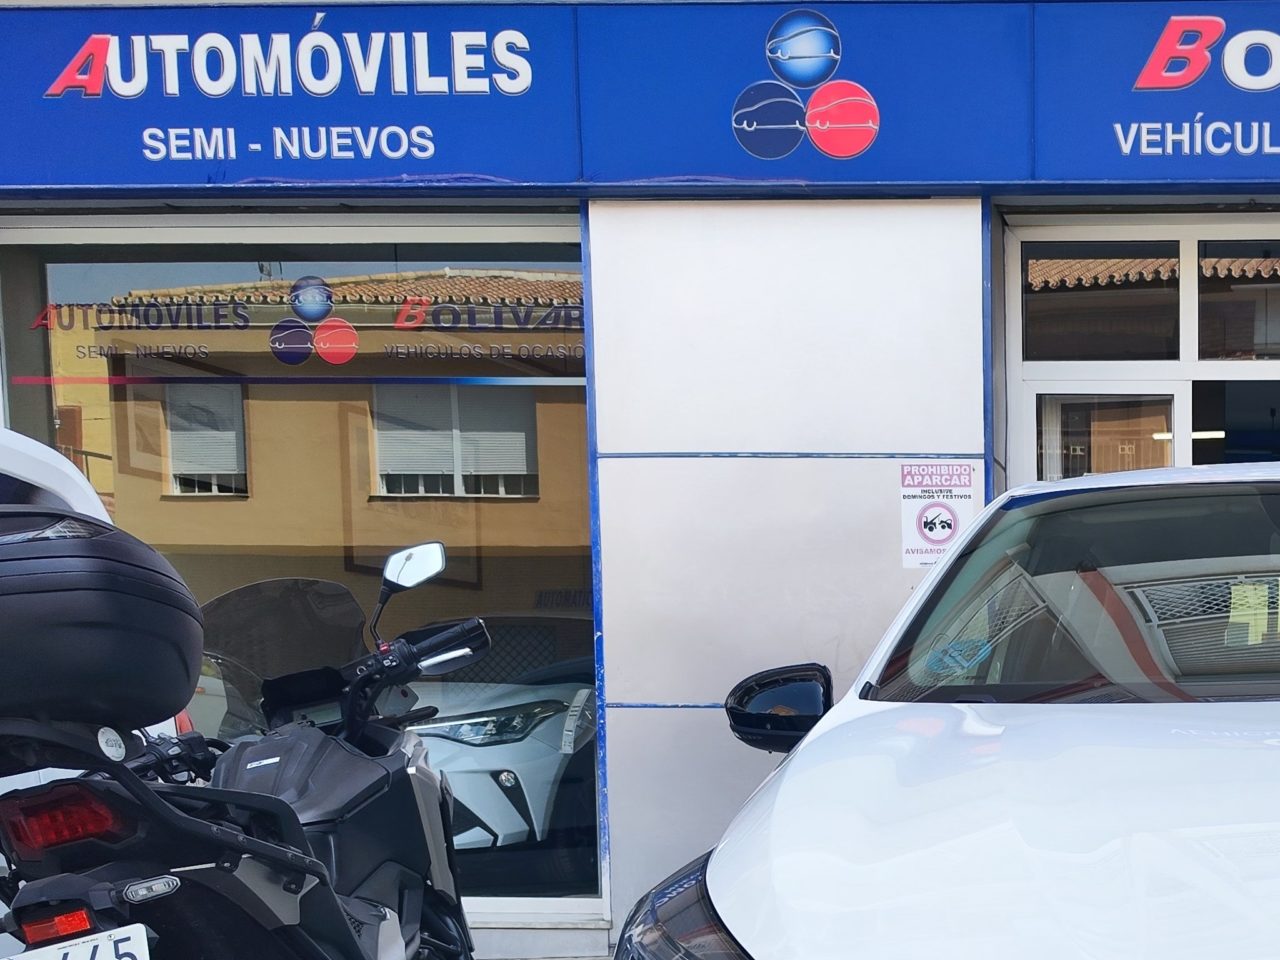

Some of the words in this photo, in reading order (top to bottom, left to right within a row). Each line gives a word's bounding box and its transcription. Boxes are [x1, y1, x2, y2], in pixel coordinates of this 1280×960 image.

[44, 13, 532, 98] AUTOMÓVILES
[142, 126, 236, 161] SEMI
[272, 125, 436, 161] NUEVOS
[75, 344, 119, 359] SEMI
[136, 343, 209, 359] NUEVOS
[489, 344, 513, 359] DE
[518, 339, 585, 359] OCASIÓ
[903, 465, 970, 475] PROHIBIDO
[903, 475, 970, 486] APARCAR
